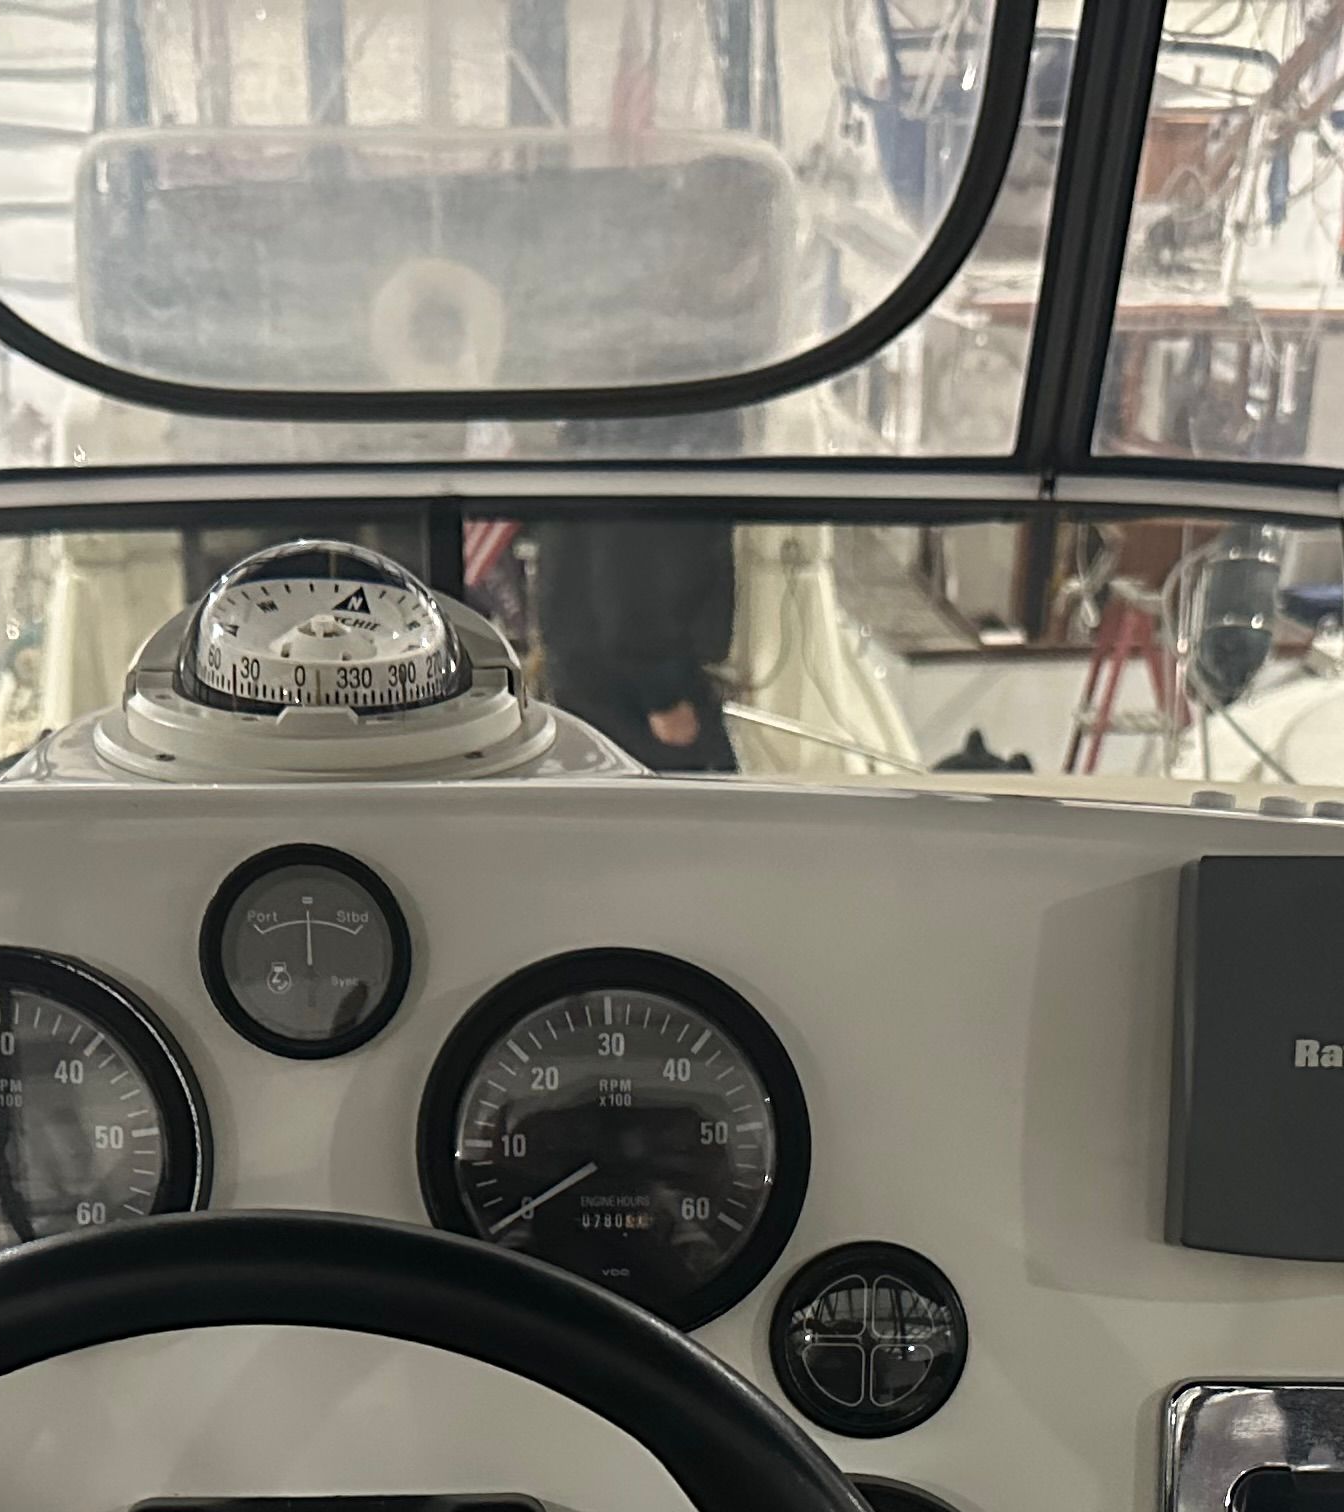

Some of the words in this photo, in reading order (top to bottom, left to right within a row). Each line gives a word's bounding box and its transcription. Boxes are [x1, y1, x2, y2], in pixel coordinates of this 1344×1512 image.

[240, 656, 260, 681] 30
[294, 665, 306, 687] 0
[336, 666, 372, 689] 330
[388, 662, 417, 684] 300
[247, 910, 279, 923] Port
[336, 910, 369, 923] Stbd
[598, 1033, 624, 1056] 30
[54, 1060, 83, 1084] 40
[531, 1067, 558, 1090] 20
[663, 1058, 690, 1081] 40
[600, 1079, 631, 1092] RPM
[95, 1126, 123, 1149] 50
[700, 1121, 728, 1145] 50
[502, 1134, 526, 1157] 10
[77, 1202, 105, 1224] 60
[681, 1197, 709, 1220] 60
